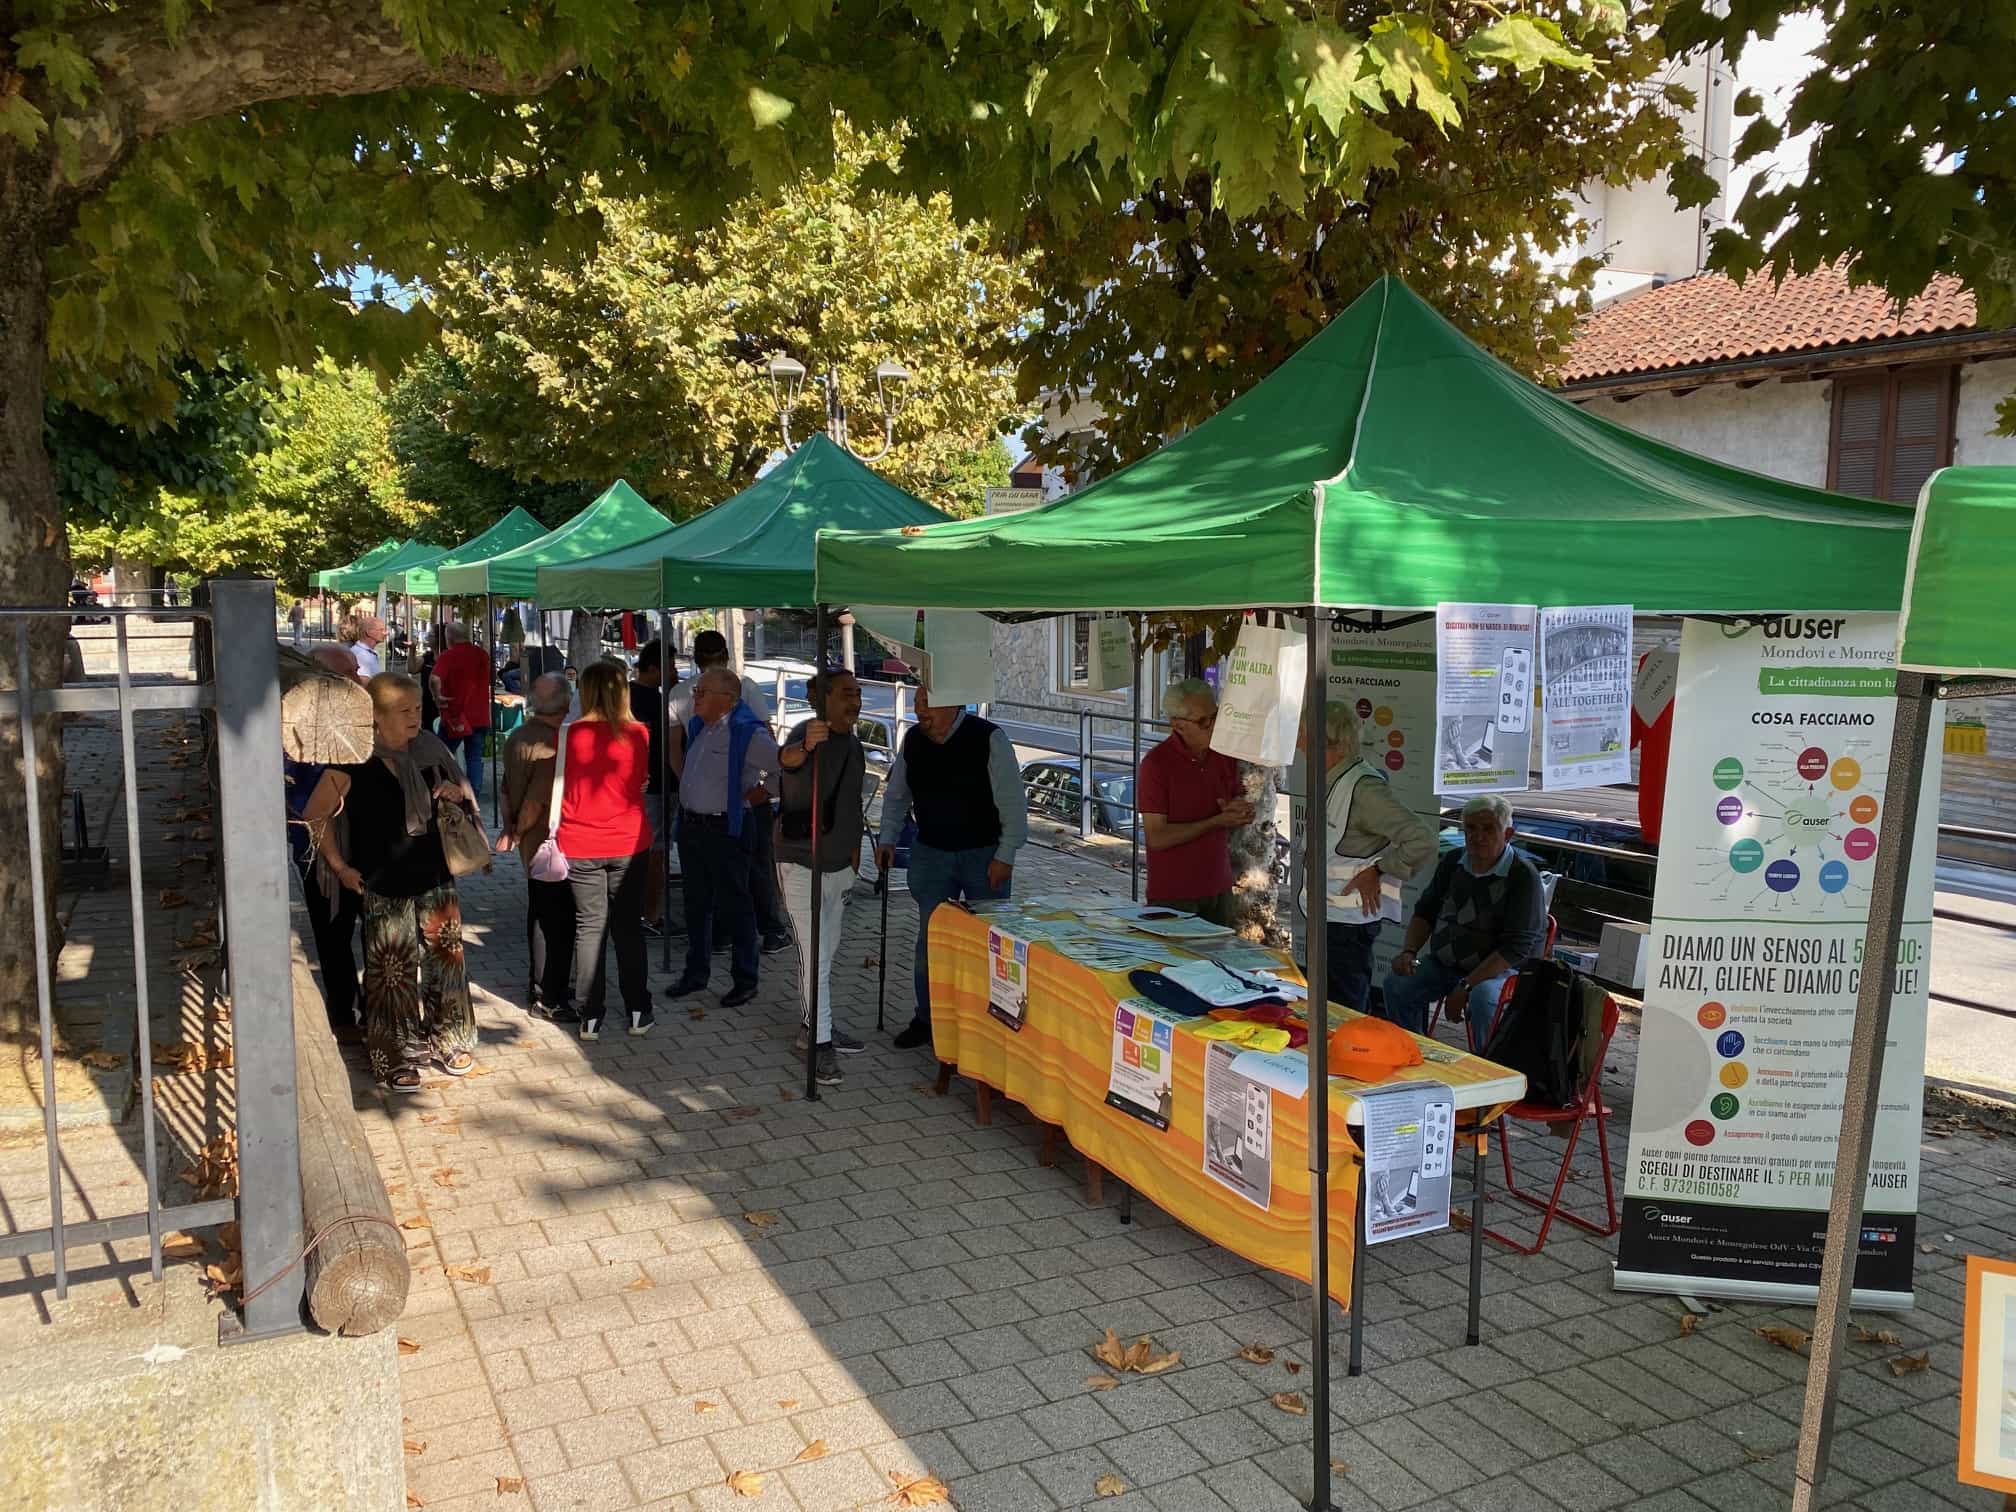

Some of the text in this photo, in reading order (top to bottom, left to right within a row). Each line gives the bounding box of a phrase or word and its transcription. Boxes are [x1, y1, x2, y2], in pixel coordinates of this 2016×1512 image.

[1828, 650, 1836, 658] e
[1840, 646, 1896, 663] Monreg
[1329, 676, 1401, 688] COSA FACCIAMO
[1768, 676, 1784, 687] La
[1788, 676, 1856, 688] cittadinanza
[1859, 680, 1882, 688] non
[1573, 693, 1624, 706] TOGETHER
[1752, 712, 1875, 726] COSA FACCIAMO
[1802, 817, 1830, 826] auser
[1662, 934, 1724, 962] DIAMO
[1730, 936, 1756, 962] UN
[1762, 937, 1822, 964] SENSO
[1827, 938, 1848, 964] AL
[1659, 964, 1918, 996] ANZI, GLIENE DIAMO CUE!
[1642, 1147, 1662, 1158] Auser
[1683, 1152, 1708, 1163] giorno
[1742, 1154, 1767, 1166] servizi
[1640, 1160, 1679, 1177] SCEGLI
[1682, 1164, 1695, 1178] DI
[1699, 1165, 1761, 1184] DESTINARE
[1764, 1168, 1774, 1184] IL
[1778, 1170, 1785, 1185] 5
[1790, 1171, 1810, 1187] PER
[1638, 1176, 1740, 1199] C.F. 97321610582
[1660, 1214, 1693, 1224] auser
